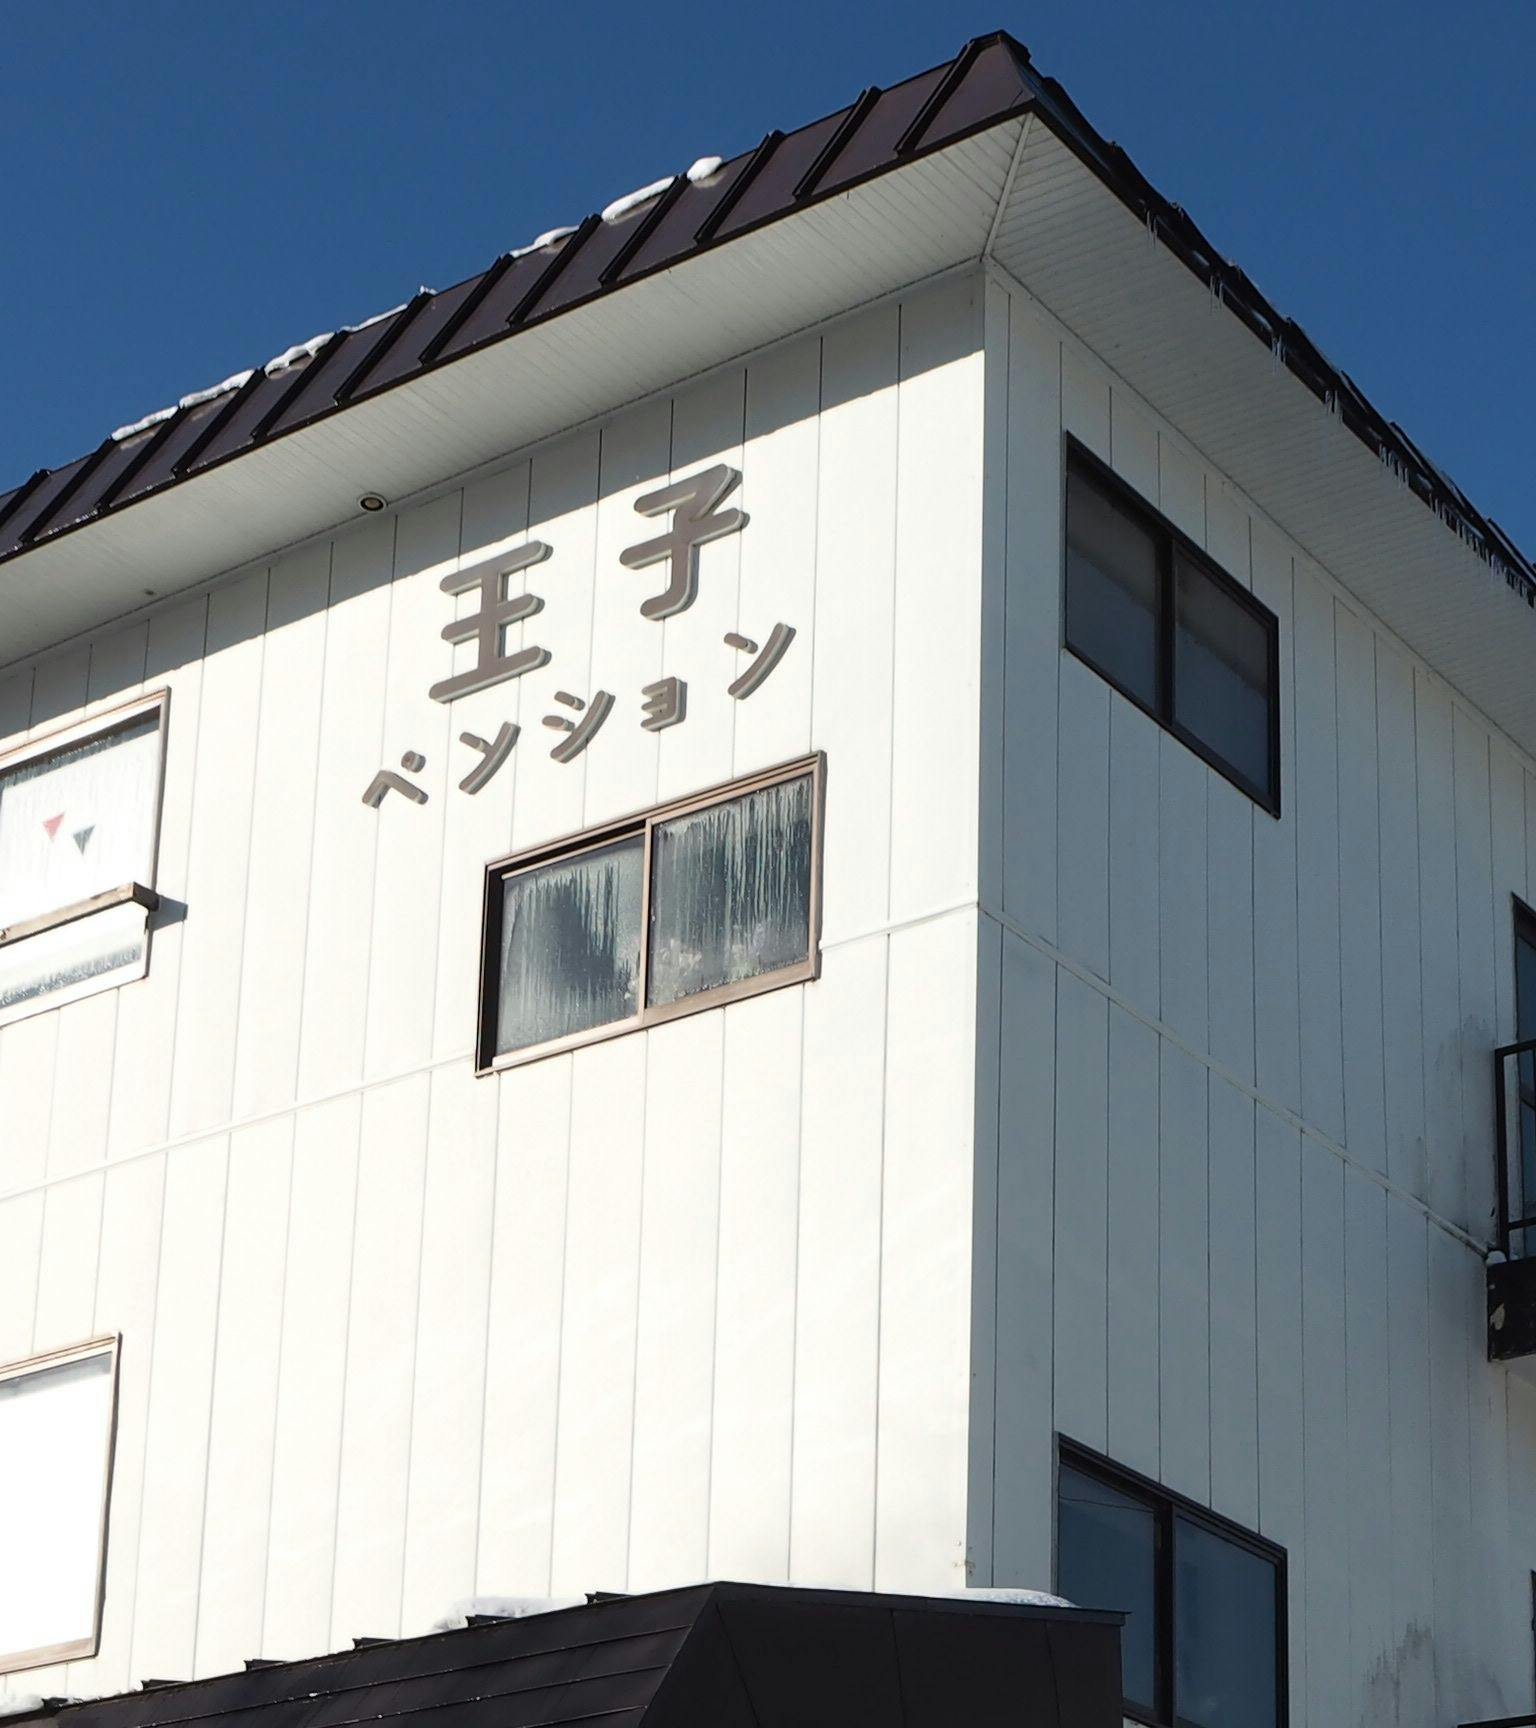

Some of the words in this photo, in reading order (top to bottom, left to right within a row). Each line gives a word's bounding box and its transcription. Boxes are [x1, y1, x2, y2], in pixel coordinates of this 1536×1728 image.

[428, 462, 751, 706] 王子
[361, 621, 797, 810] ペンション
